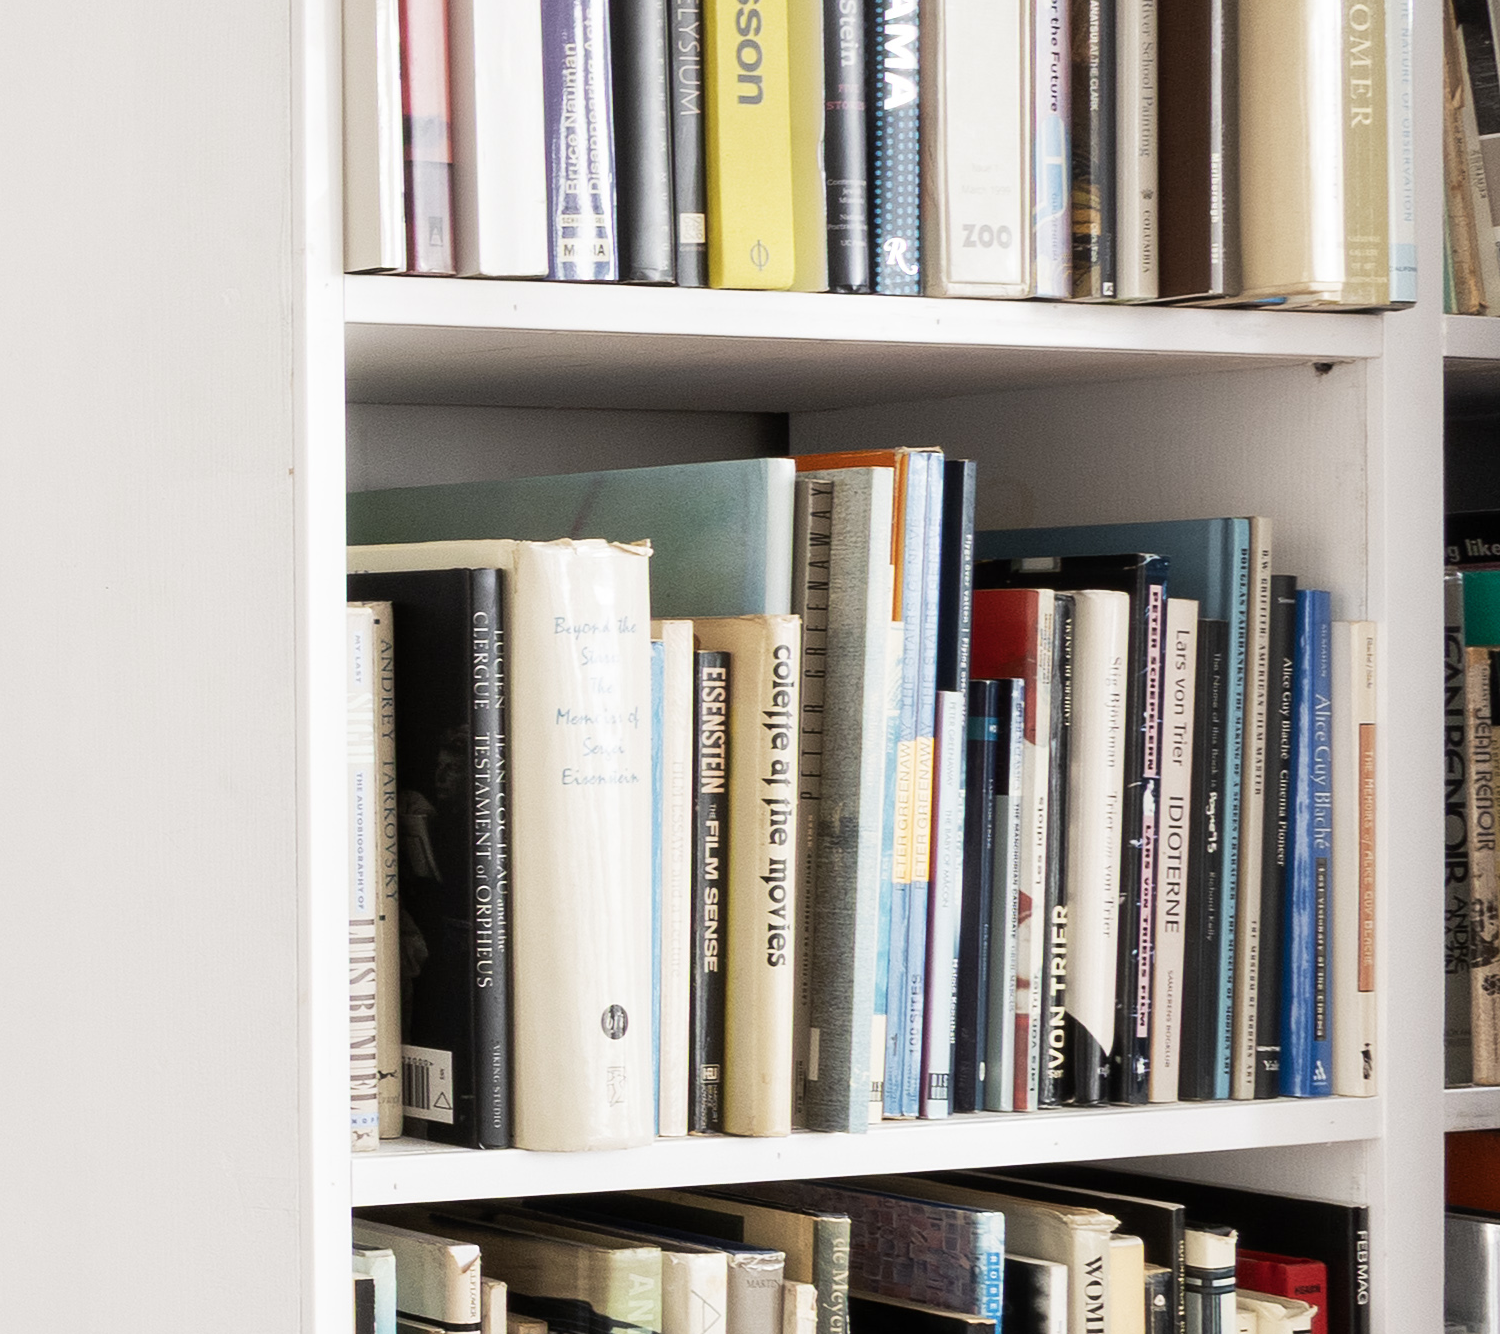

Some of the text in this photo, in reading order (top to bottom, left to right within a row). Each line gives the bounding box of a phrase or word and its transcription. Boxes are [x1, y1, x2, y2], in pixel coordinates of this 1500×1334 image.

[699, 663, 727, 974] EISENSTEIN FILM SENSE
